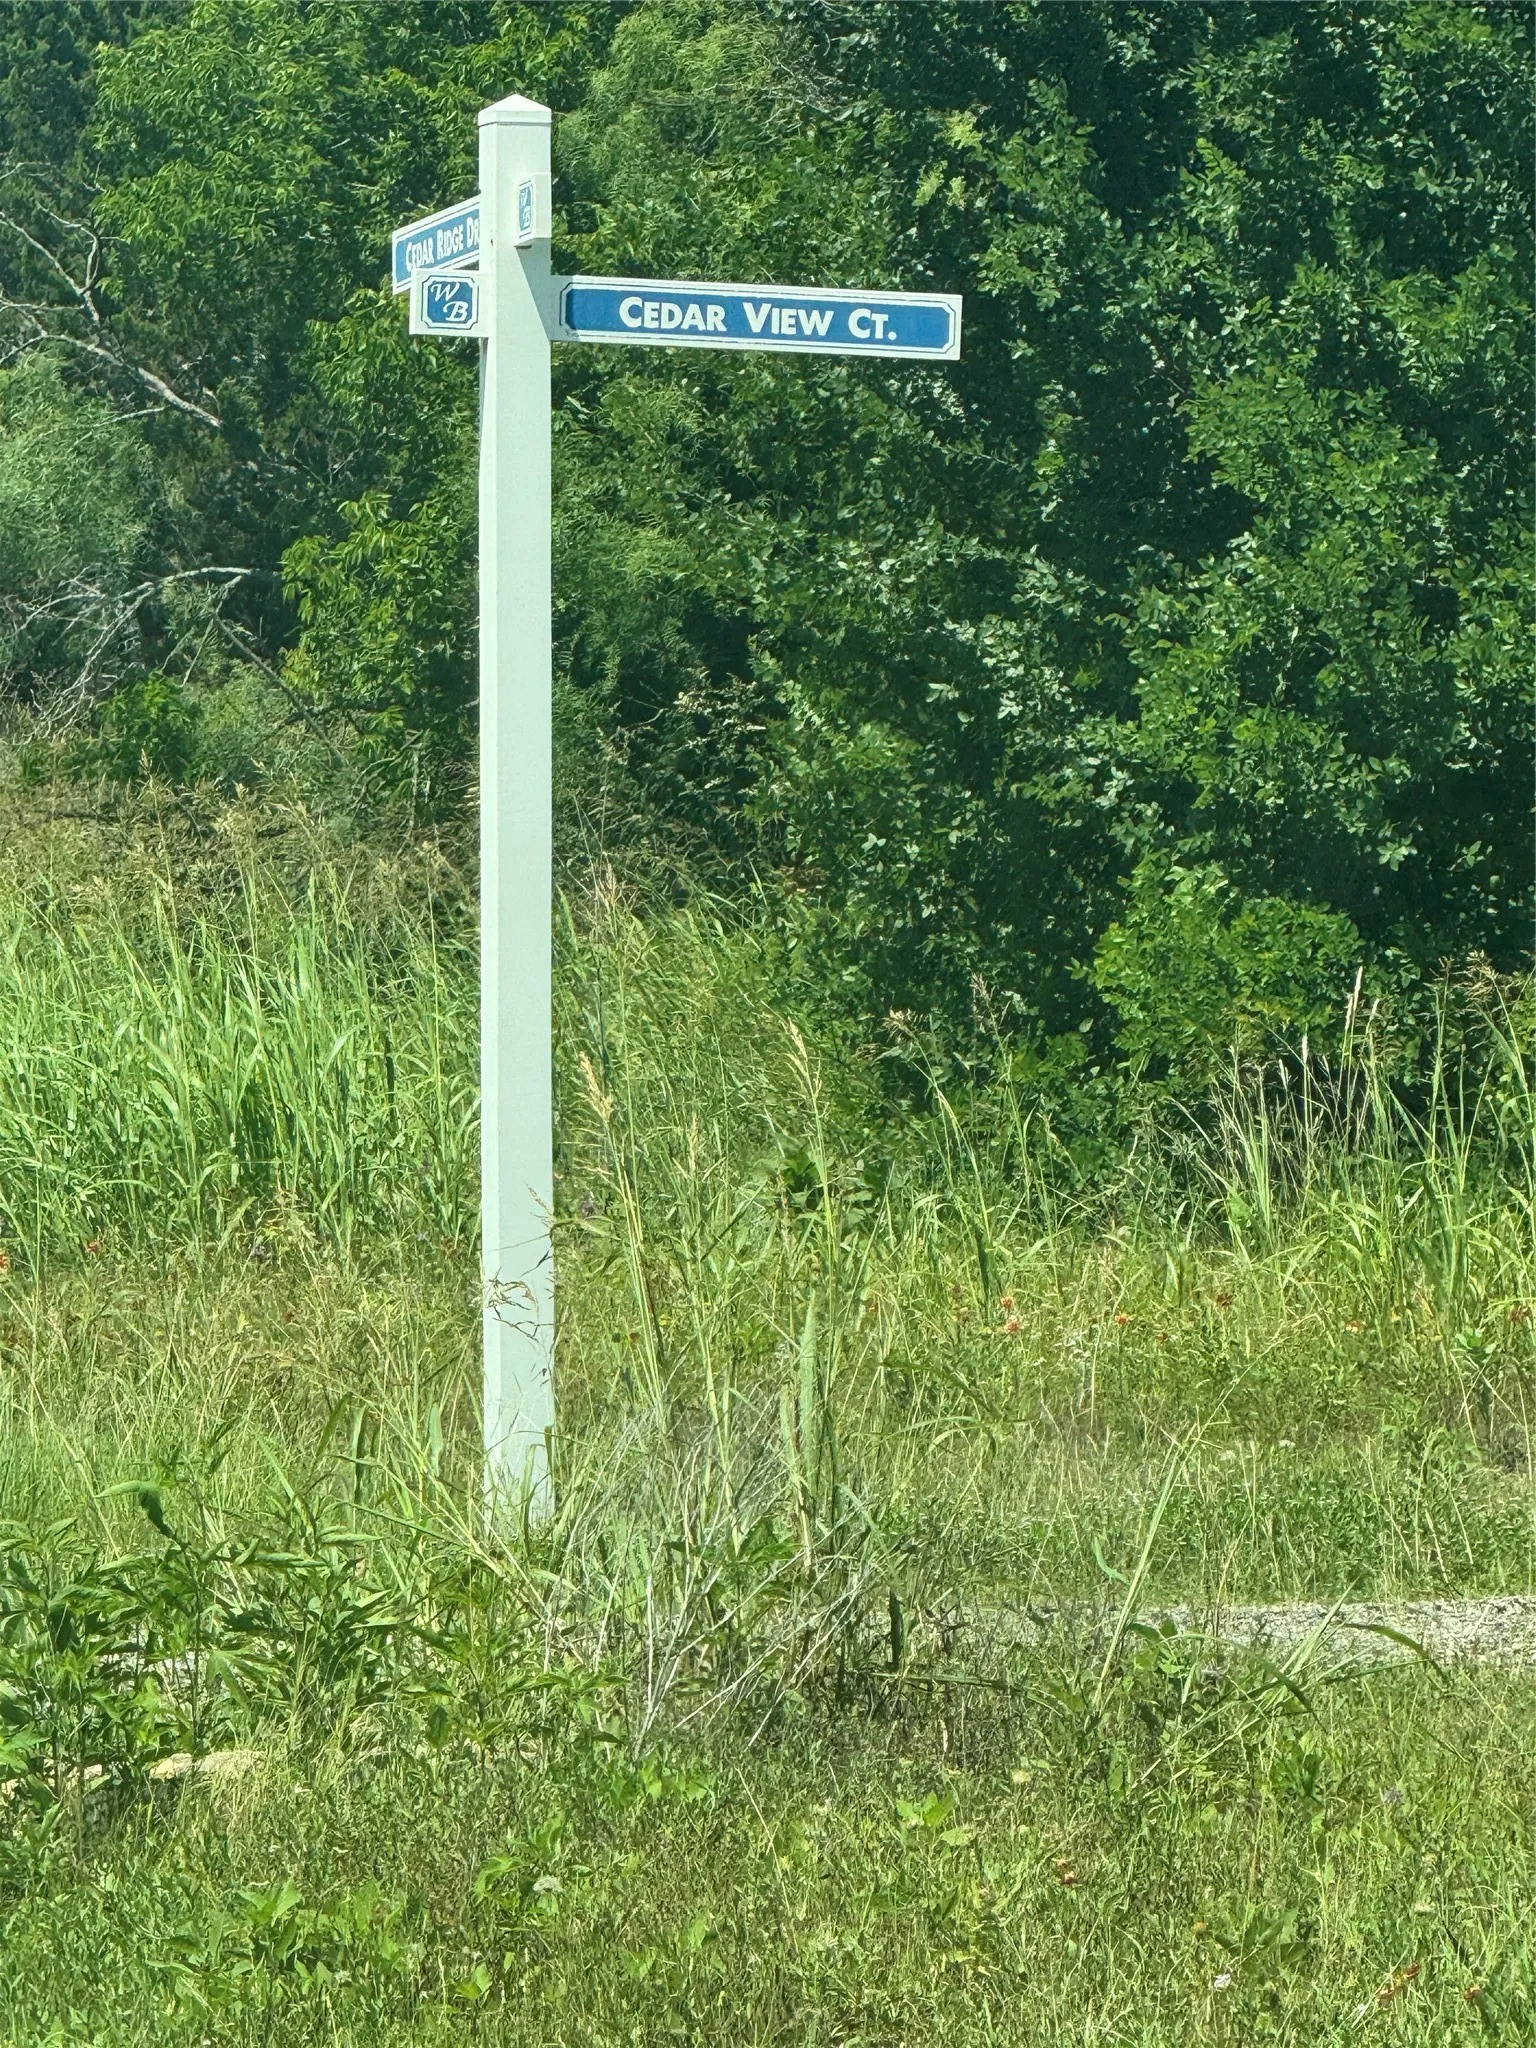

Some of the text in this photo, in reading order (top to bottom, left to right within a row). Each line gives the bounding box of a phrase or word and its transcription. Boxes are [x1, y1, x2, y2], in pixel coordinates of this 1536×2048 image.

[405, 238, 434, 272] CEDAR
[437, 224, 464, 260] RIDGE
[619, 296, 897, 341] CEDAR VIEW CT.
